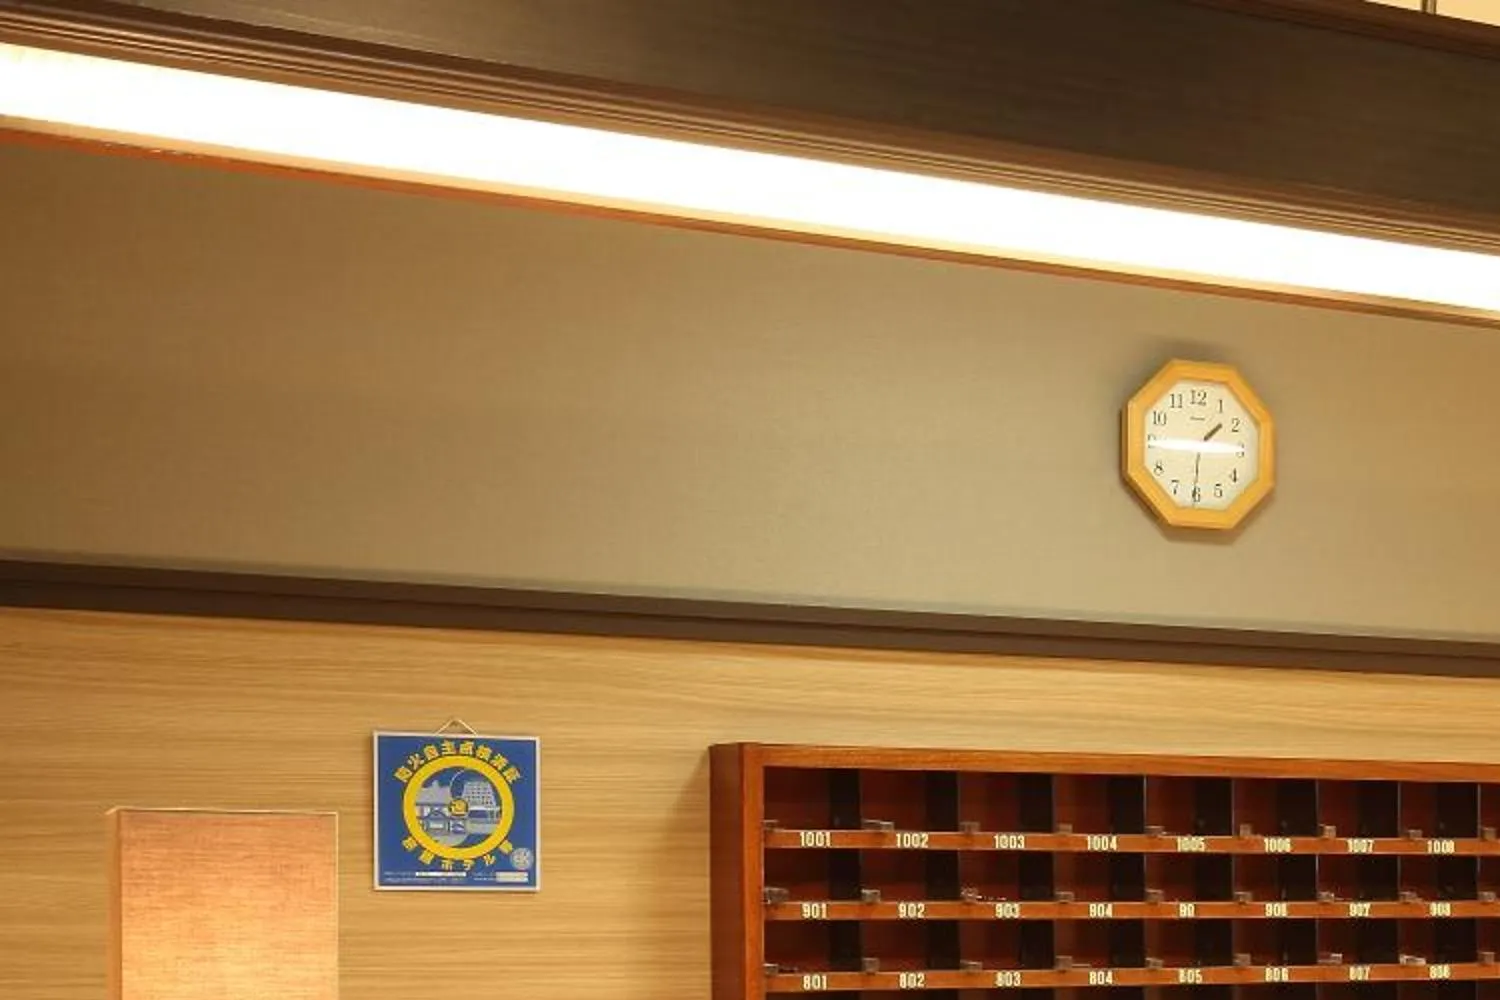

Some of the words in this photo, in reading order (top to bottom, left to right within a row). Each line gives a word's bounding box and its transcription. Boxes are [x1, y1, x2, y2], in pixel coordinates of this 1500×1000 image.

[1169, 393, 1183, 408] 11
[1189, 390, 1207, 406] 12
[1218, 399, 1223, 414] 1
[1153, 410, 1167, 425] 10
[1231, 418, 1240, 433] 2
[1153, 460, 1164, 476] 8
[1228, 468, 1238, 483] 4
[1169, 479, 1180, 495] 7
[1192, 485, 1201, 503] 6
[1214, 483, 1223, 498] 5
[799, 831, 831, 847] 1001
[895, 832, 929, 848] 1002
[993, 834, 1025, 849] 1003
[1086, 835, 1117, 851] 1004
[1176, 836, 1205, 852] 1005
[1263, 837, 1291, 853] 1006
[1347, 838, 1374, 853] 1007
[1427, 839, 1455, 854] 1008
[801, 902, 827, 918] 901
[898, 902, 925, 919] 902
[995, 902, 1020, 918] 903
[1089, 903, 1113, 918] 904
[1349, 902, 1371, 918] 907
[899, 972, 925, 989] 802
[996, 971, 1021, 987] 803
[1089, 970, 1113, 986] 804
[1178, 968, 1203, 984] 805
[1265, 967, 1289, 982] 806
[1349, 965, 1371, 981] 807
[803, 974, 827, 991] 801
